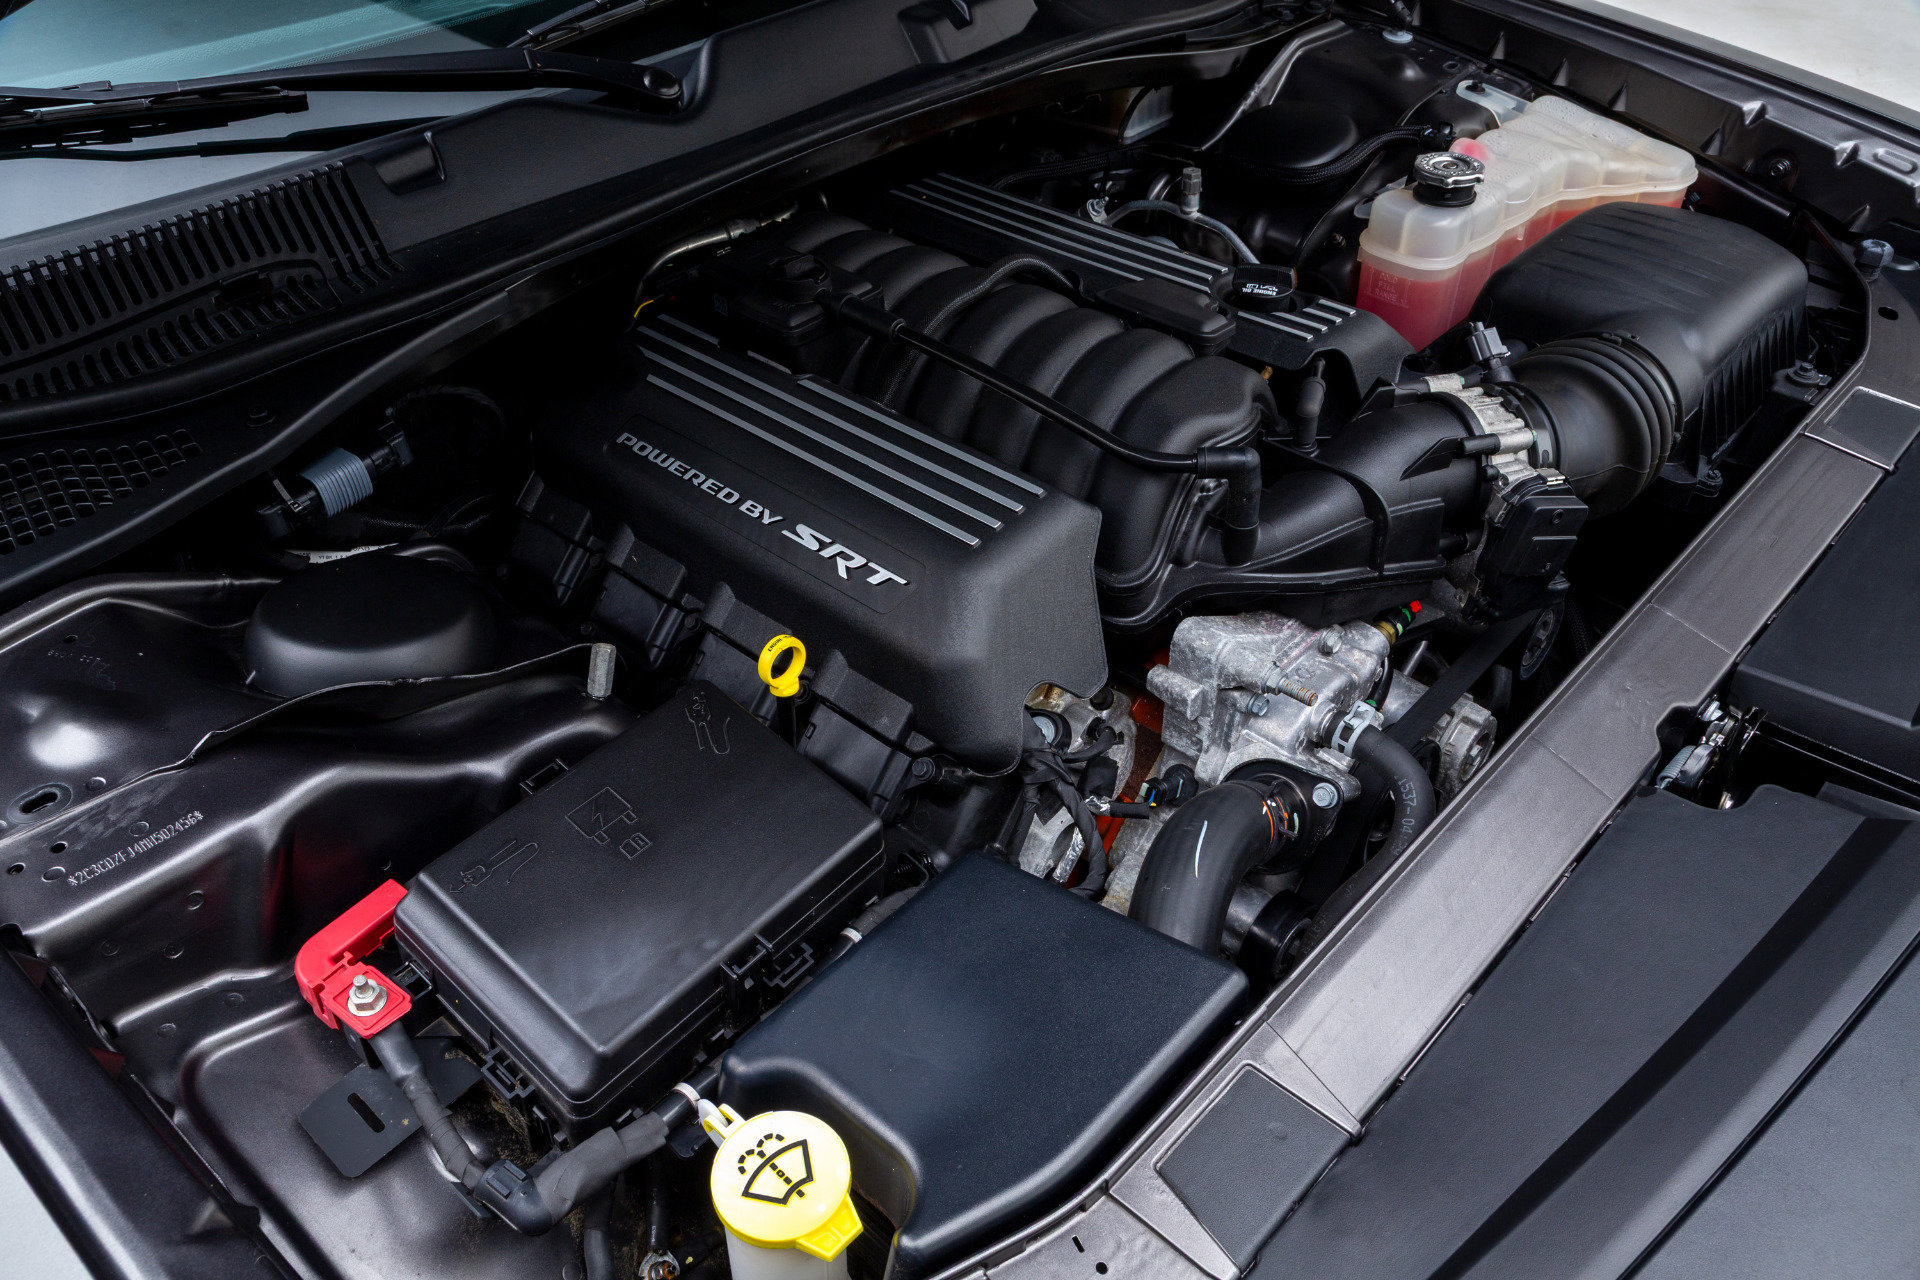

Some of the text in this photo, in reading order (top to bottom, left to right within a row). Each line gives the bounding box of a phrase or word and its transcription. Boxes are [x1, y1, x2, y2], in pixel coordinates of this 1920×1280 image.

[1252, 288, 1277, 296] ENGINE
[616, 432, 909, 586] POWERED BY SRT
